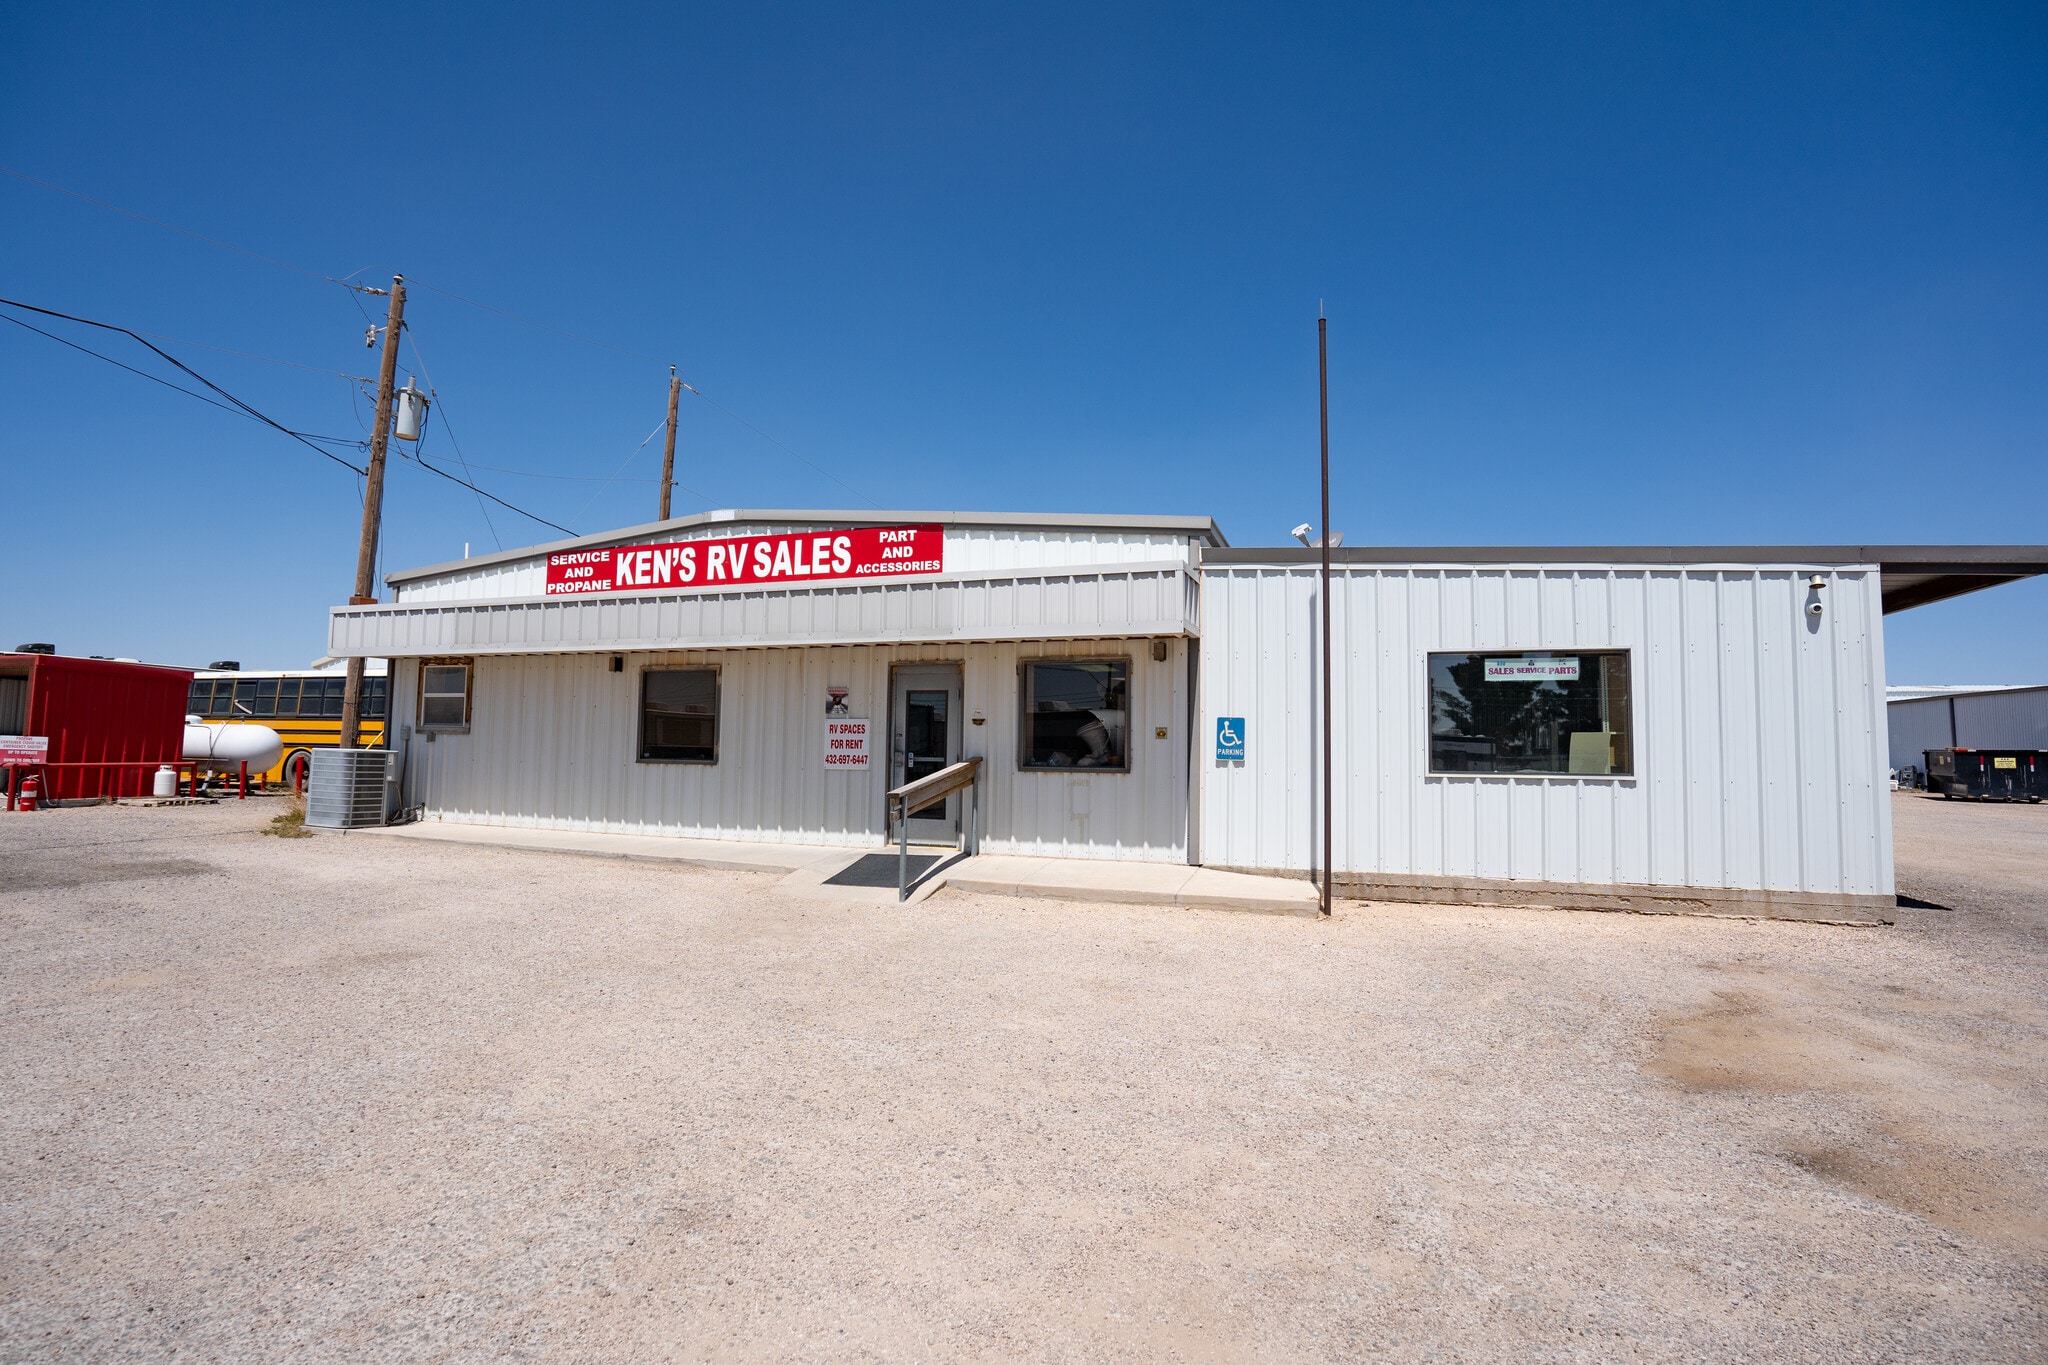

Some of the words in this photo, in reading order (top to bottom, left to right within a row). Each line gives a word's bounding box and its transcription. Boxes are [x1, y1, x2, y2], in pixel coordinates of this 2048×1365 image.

[879, 529, 918, 543] PART
[550, 551, 610, 566] SERVICE
[881, 545, 914, 559] AND
[615, 547, 697, 587] KEN'S
[706, 543, 749, 581] RV
[752, 535, 852, 579] SALES
[855, 560, 941, 574] ACCESSORIES
[564, 566, 594, 579] AND
[547, 579, 611, 594] PROPANE
[829, 724, 838, 734] RV
[840, 724, 866, 734] SPACES
[830, 739, 844, 749] FOR
[845, 739, 863, 749] RENT
[825, 754, 868, 765] 432-697-6447
